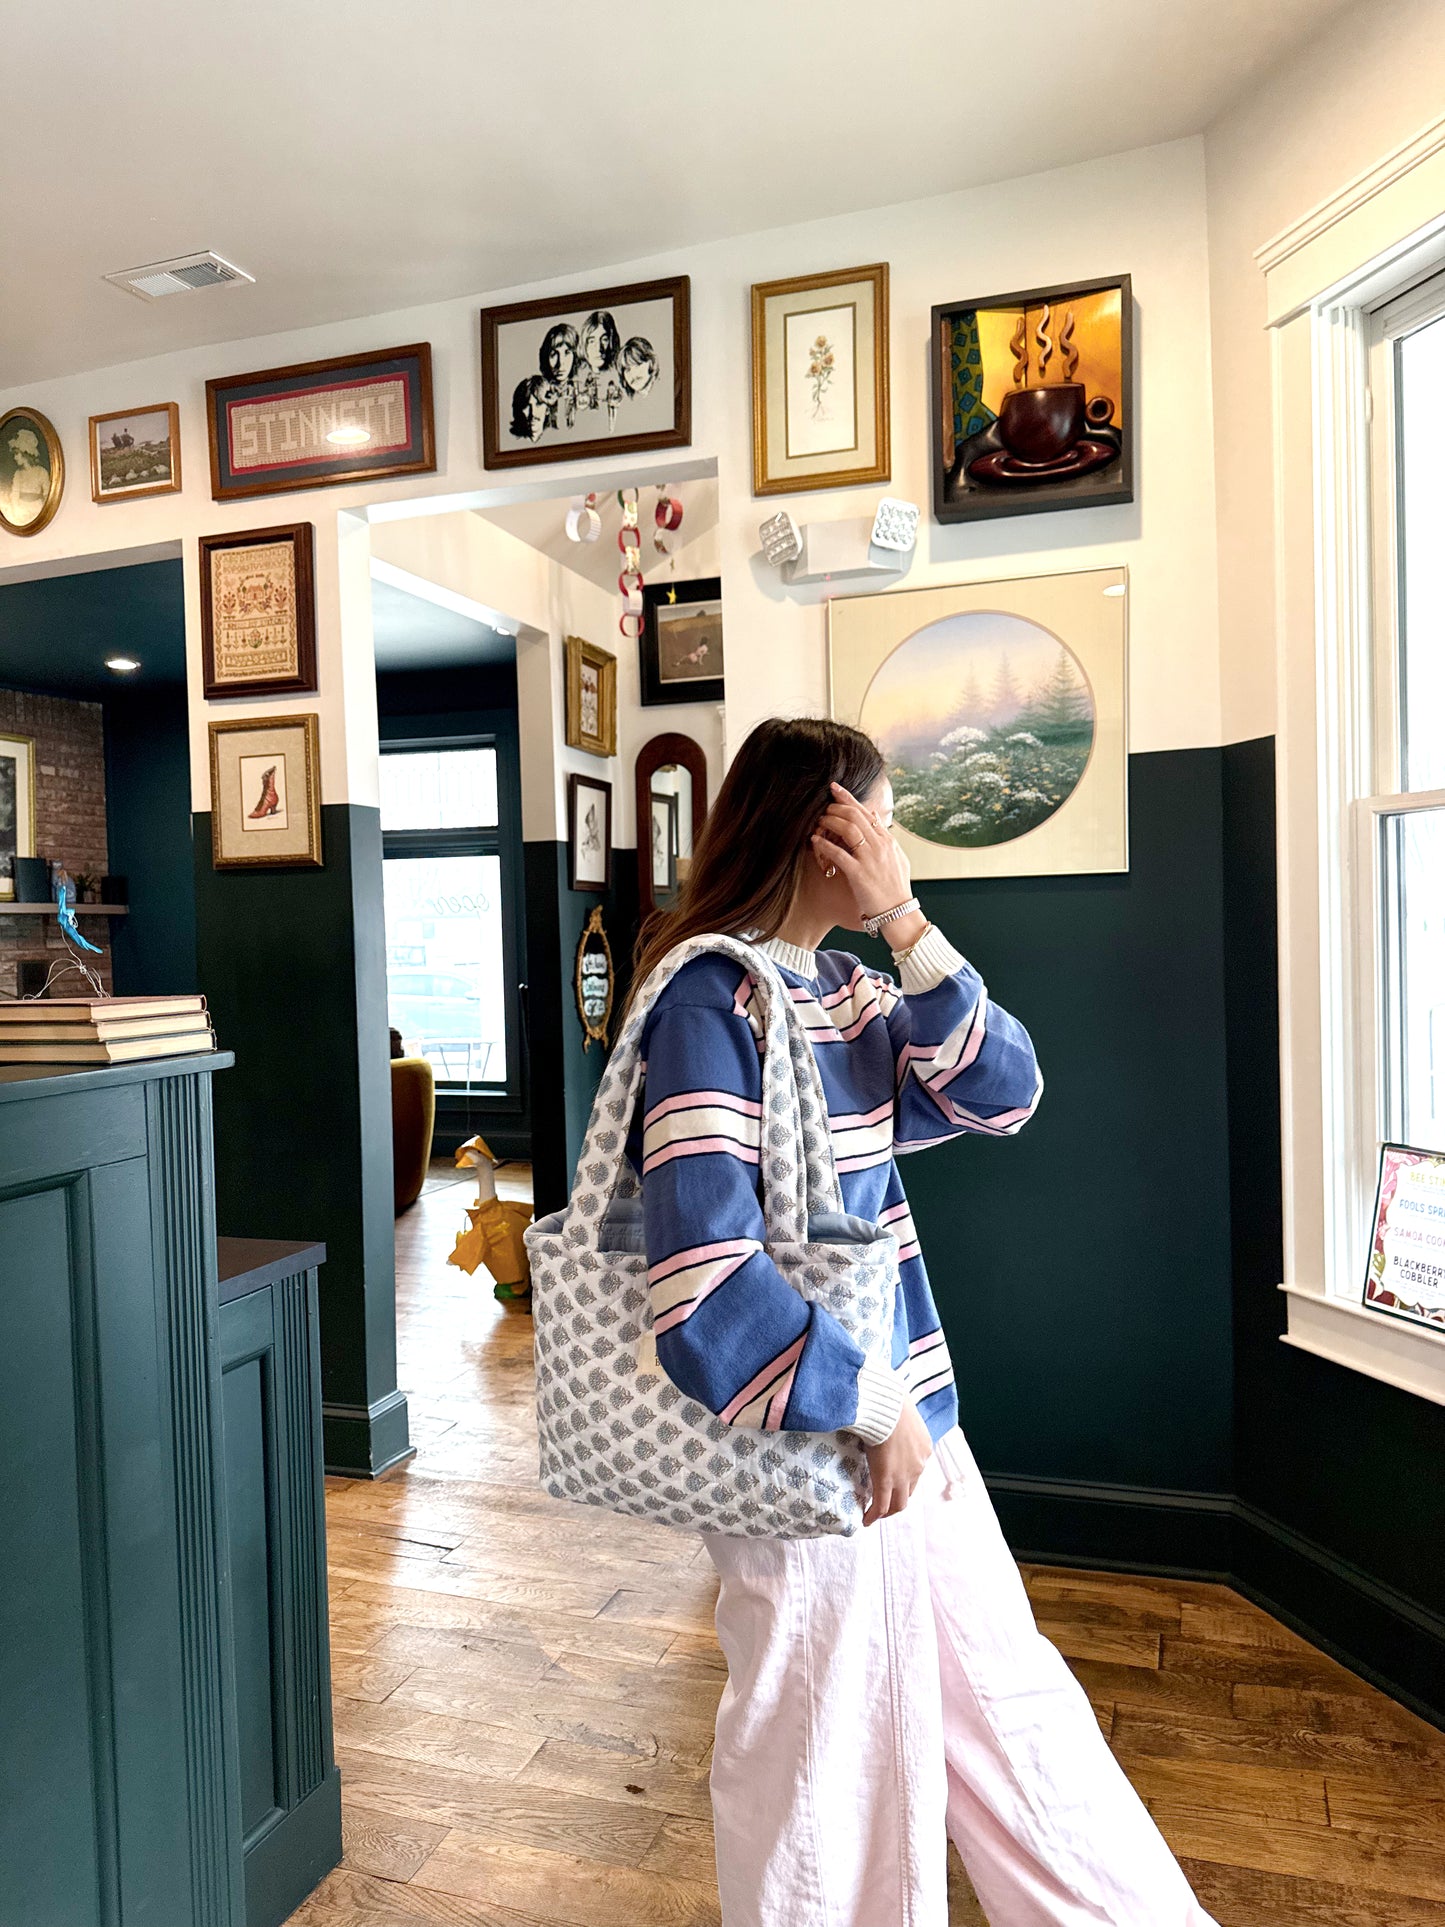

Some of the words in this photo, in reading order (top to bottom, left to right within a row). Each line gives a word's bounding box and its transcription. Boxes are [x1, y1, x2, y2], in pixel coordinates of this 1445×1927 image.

[1410, 1171, 1425, 1184] BEE
[1399, 1198, 1426, 1213] FOOLS
[1394, 1226, 1424, 1242] SAMOA
[1400, 1268, 1439, 1289] COBBLER
